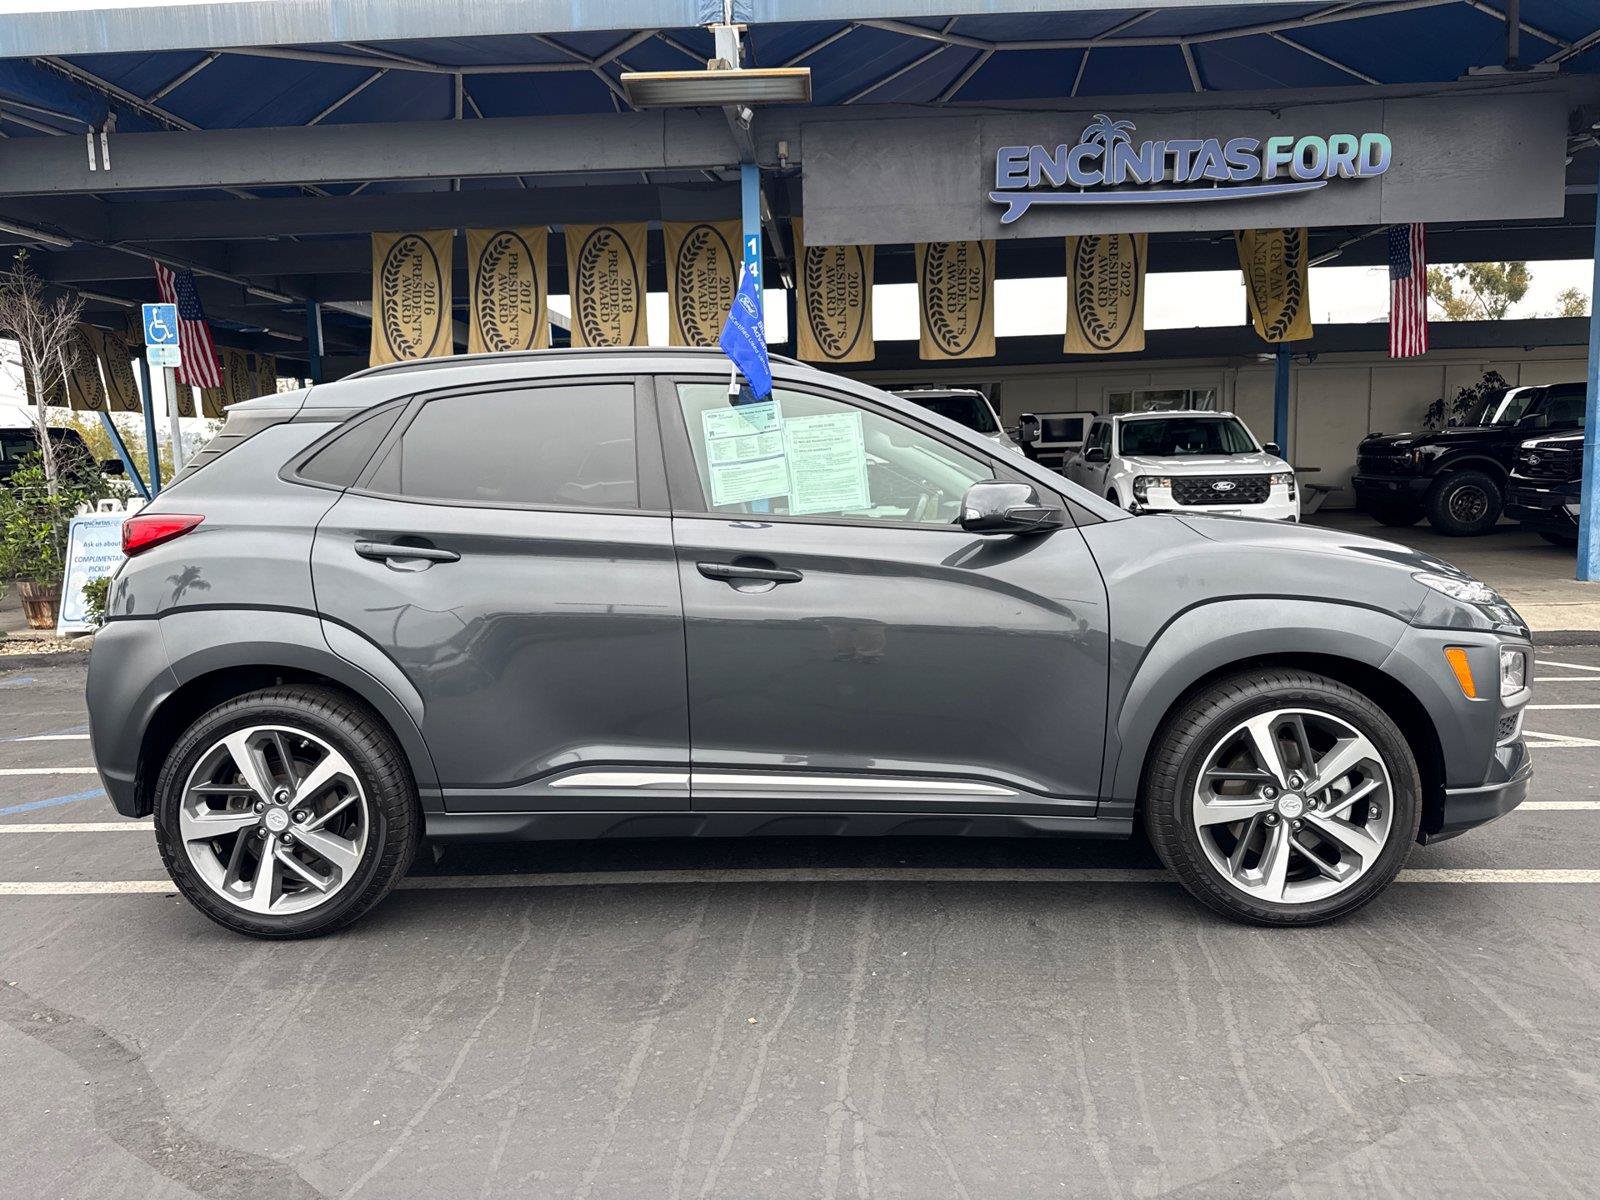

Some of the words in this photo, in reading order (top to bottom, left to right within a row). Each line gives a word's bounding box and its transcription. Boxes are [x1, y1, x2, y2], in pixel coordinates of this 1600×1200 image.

[995, 137, 1261, 188] ENCINITAS
[1264, 133, 1392, 180] FORD
[520, 280, 532, 315] 2017
[598, 270, 610, 323] AWARD
[608, 250, 622, 345] PRESIDENT'S
[621, 278, 633, 313] 2018
[697, 268, 709, 322] AWARD
[706, 247, 720, 343] PRESIDENT'S
[719, 276, 731, 312] 2019
[825, 264, 837, 318] AWARD
[847, 271, 859, 308] 2020
[946, 261, 958, 314] AWARD
[969, 267, 981, 302] 2021
[1098, 254, 1108, 308] AWARD
[1107, 234, 1119, 330] PRESIDENT'S
[1120, 261, 1131, 297] 2022
[1270, 238, 1284, 304] AWARD
[402, 275, 412, 325] AWARD
[411, 254, 423, 346] PRESIDENT'S
[423, 281, 435, 316] 2016
[498, 273, 508, 324] AWARD
[508, 253, 519, 346] PRESIDENT'S
[75, 555, 123, 563] COMPLIMENTAR
[88, 565, 110, 573] PICKUP
